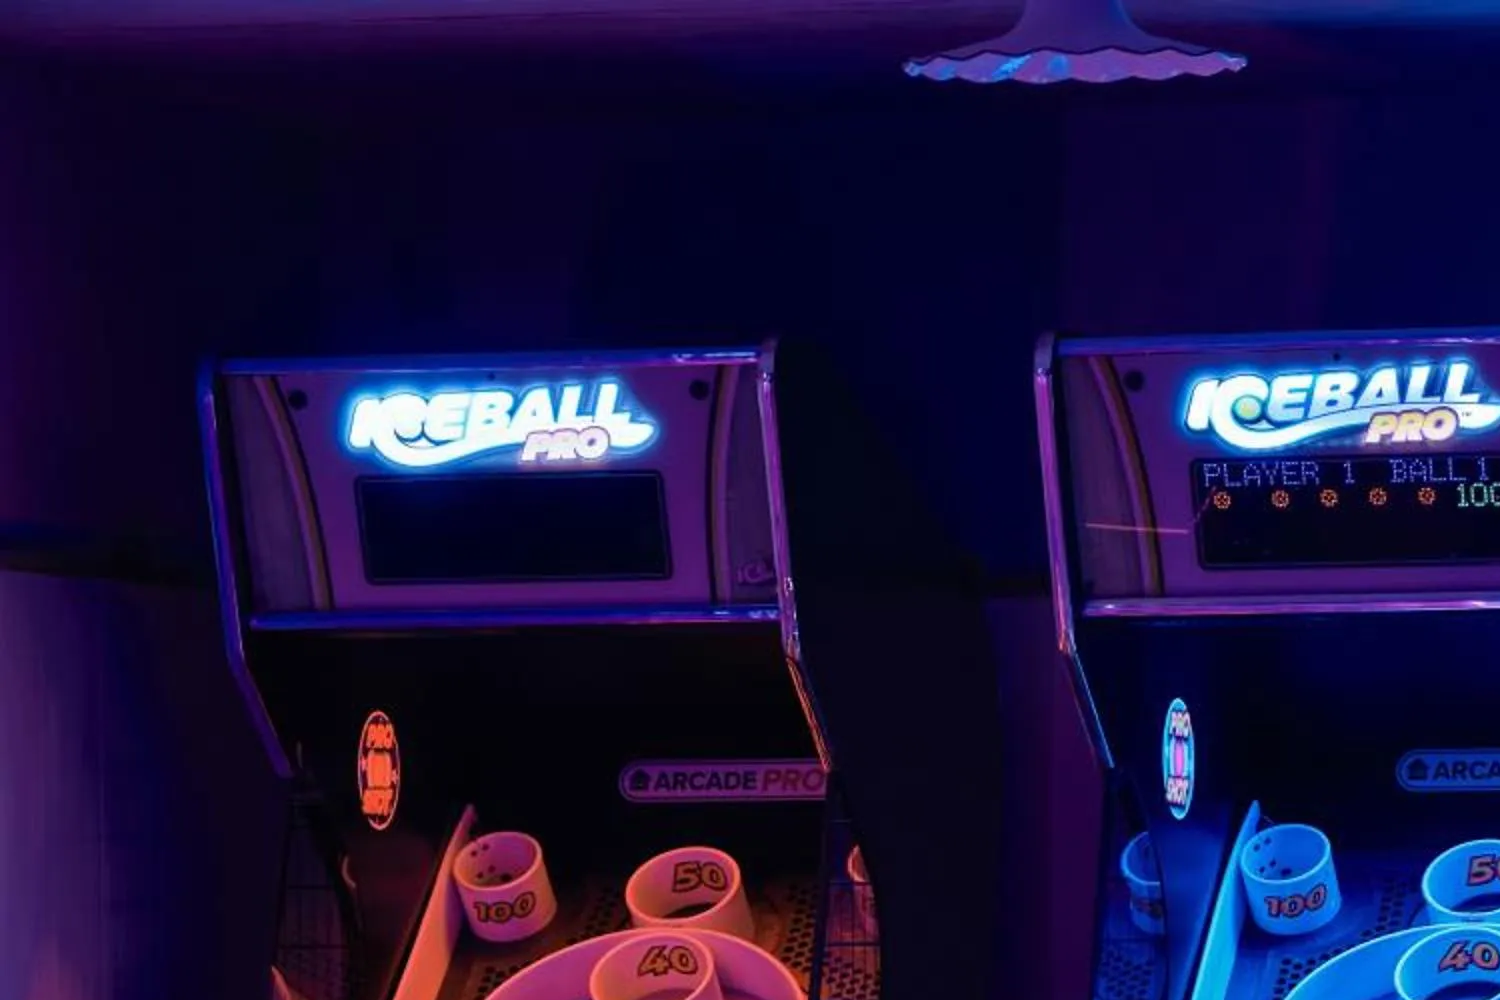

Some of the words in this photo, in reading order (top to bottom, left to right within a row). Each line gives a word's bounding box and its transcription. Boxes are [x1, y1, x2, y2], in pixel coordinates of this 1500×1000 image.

[347, 383, 655, 467] ICEBALL
[1364, 406, 1460, 443] PRO
[520, 426, 611, 463] PRO
[1203, 461, 1320, 487] PLAYER
[1343, 461, 1355, 484] 1
[1389, 458, 1467, 483] BALL
[1477, 457, 1490, 481] 1
[653, 771, 757, 791] ARCADE
[762, 768, 825, 791] PRO
[671, 861, 728, 892] 50
[474, 892, 536, 925] 100
[1264, 883, 1328, 919] 100
[637, 945, 699, 977] 40
